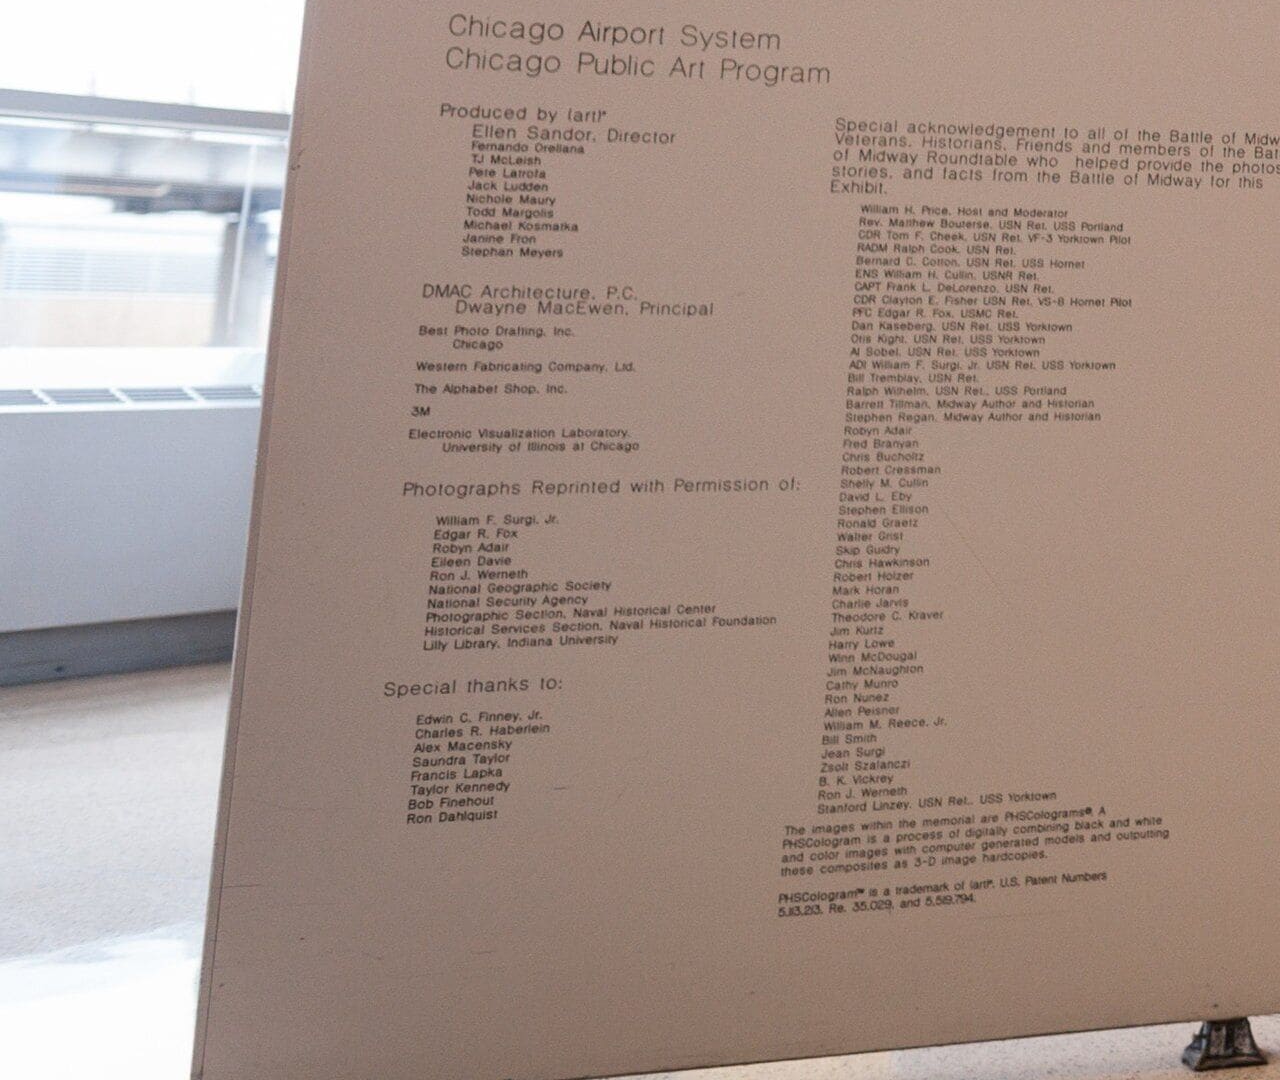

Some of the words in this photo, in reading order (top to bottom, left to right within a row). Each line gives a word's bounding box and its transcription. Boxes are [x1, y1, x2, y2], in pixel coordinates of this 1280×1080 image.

[447, 12, 564, 46] Chicago
[576, 19, 665, 46] Airport
[680, 23, 780, 52] System
[444, 45, 562, 78] Chicago
[576, 50, 654, 77] Public
[668, 55, 705, 79] Art
[719, 57, 830, 88] Program
[438, 102, 528, 121] Produced
[536, 106, 558, 124] by
[471, 122, 517, 139] Ellen
[526, 124, 596, 142] Sandor,
[606, 126, 676, 145] Director
[421, 282, 472, 302] DMAC
[479, 283, 595, 304] Architecture,
[605, 284, 637, 301] P.C.
[454, 297, 527, 317] Dwayne
[536, 298, 628, 316] MacEwen,
[639, 300, 714, 317] Principal
[410, 406, 431, 418] 3M
[401, 480, 521, 500] Photographs
[530, 478, 620, 496] Reprinted
[629, 478, 664, 493] with
[672, 477, 769, 493] Permission
[777, 476, 803, 492] of:
[382, 678, 457, 699] Special
[466, 676, 529, 693] thanks
[539, 676, 562, 690] to:
[415, 713, 453, 726] Edwin
[458, 711, 471, 724] C.
[477, 710, 522, 723] Finney,
[526, 709, 542, 721] Jr.
[414, 727, 463, 740] Charles
[469, 724, 482, 736] R.
[488, 723, 550, 735] Haberlein
[412, 742, 440, 753] Alex
[446, 738, 512, 752] Macensky
[411, 754, 466, 768] Saundra
[472, 752, 510, 765] Taylor
[410, 769, 457, 781] Francis
[462, 766, 503, 780] Lapka
[410, 783, 449, 797] Taylor
[454, 780, 510, 793] Kennedy
[406, 798, 434, 811] Bob
[438, 795, 494, 808] Finehout
[405, 812, 432, 824] Ron
[437, 809, 498, 823] Dahlquist
